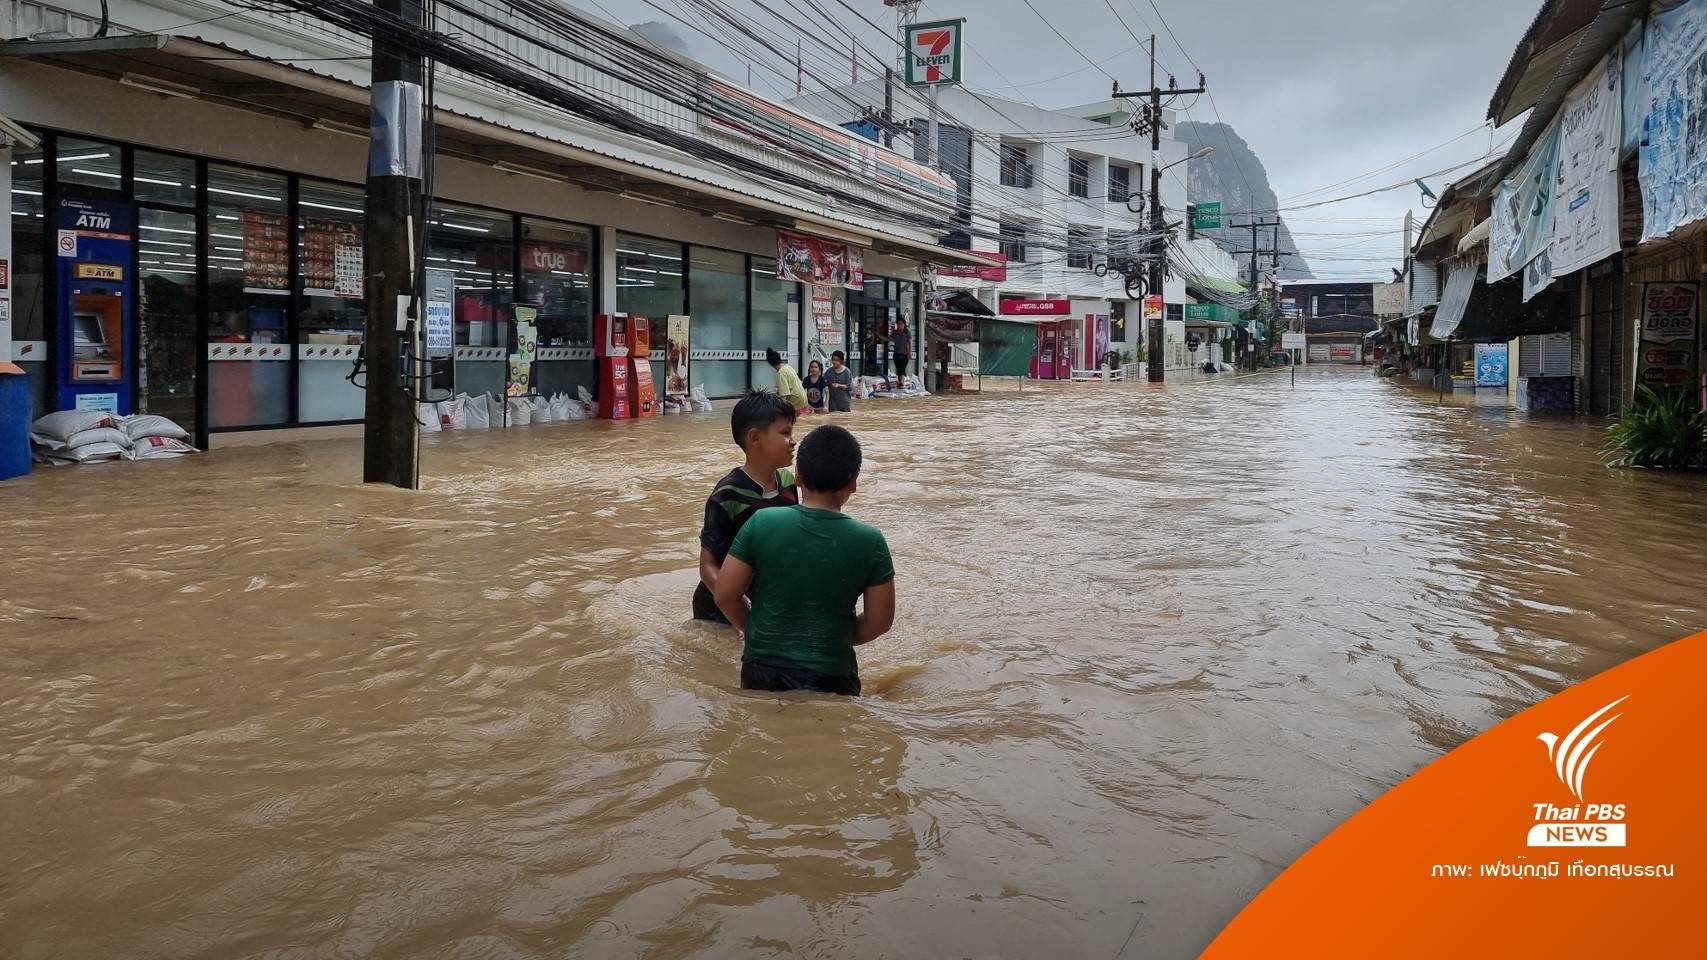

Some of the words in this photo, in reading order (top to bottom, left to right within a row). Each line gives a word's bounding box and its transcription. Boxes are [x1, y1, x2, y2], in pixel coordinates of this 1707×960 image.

[76, 215, 111, 229] ATM
[533, 247, 566, 270] true
[94, 270, 115, 278] ATM
[615, 371, 626, 379] 5G
